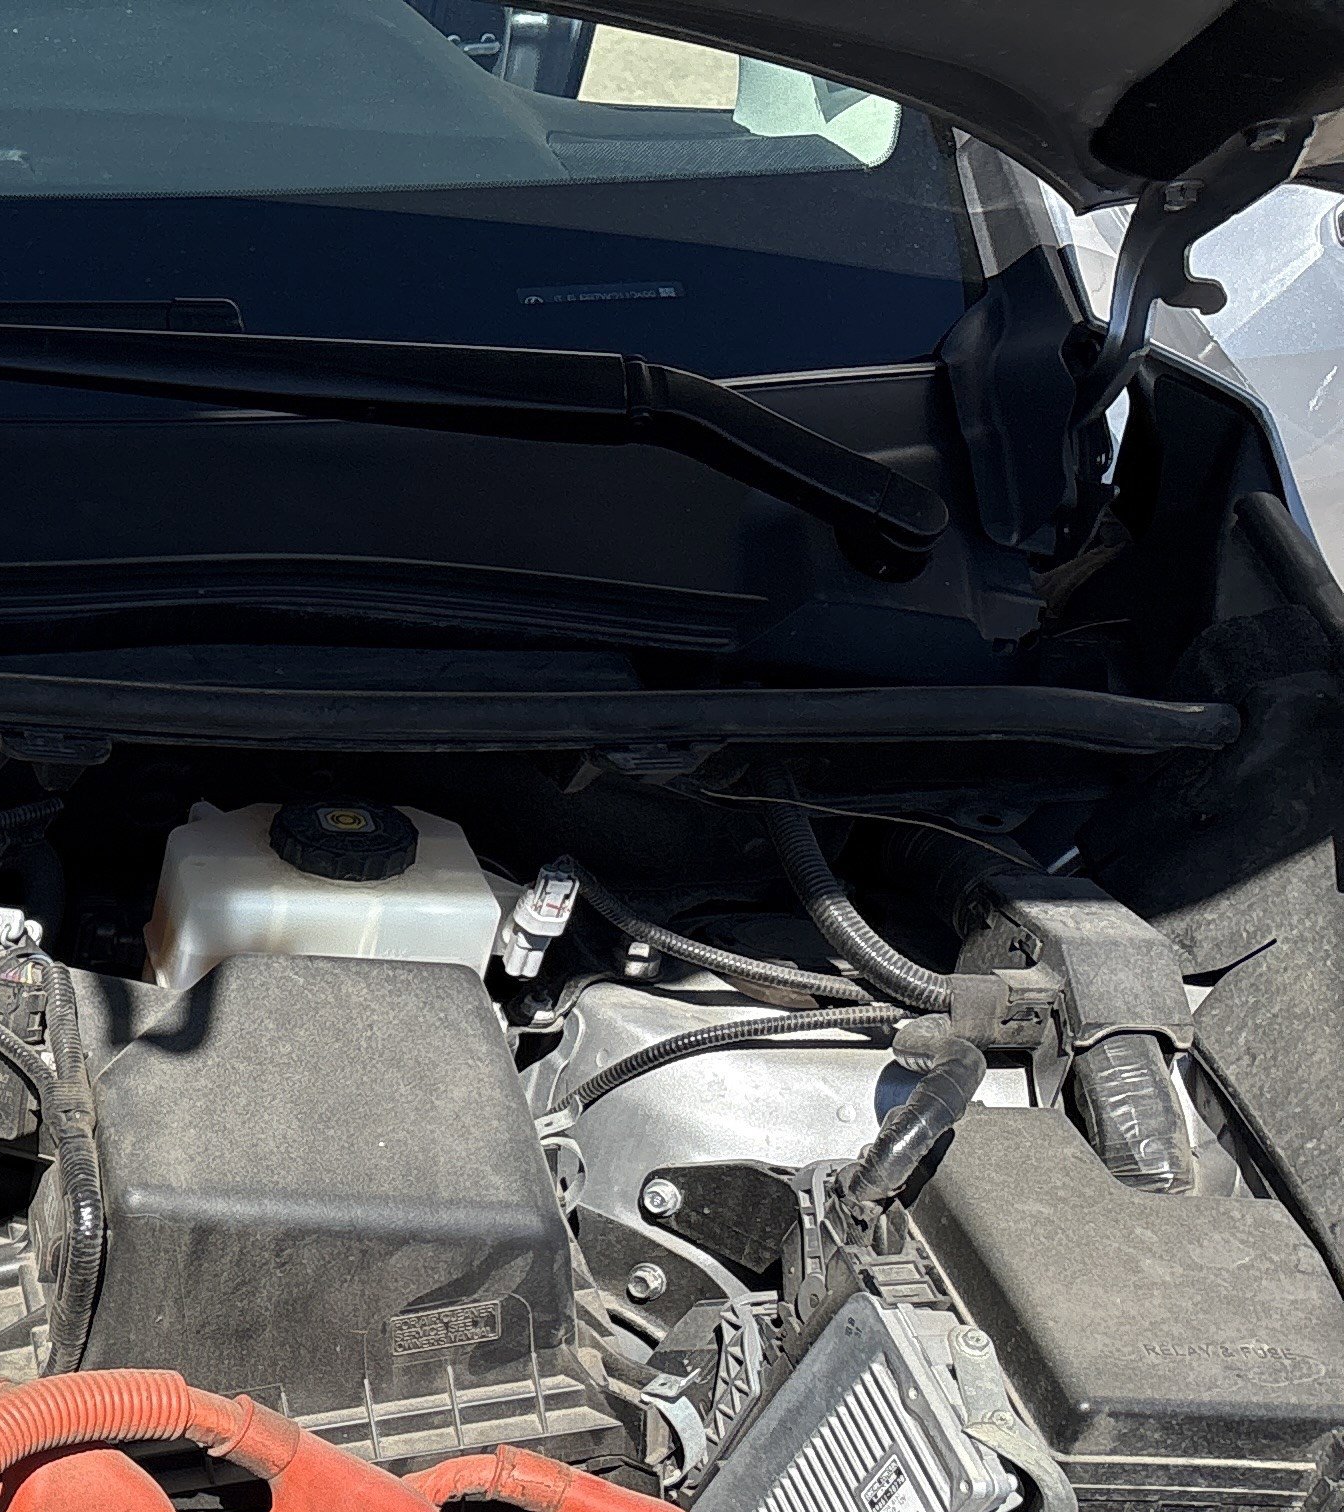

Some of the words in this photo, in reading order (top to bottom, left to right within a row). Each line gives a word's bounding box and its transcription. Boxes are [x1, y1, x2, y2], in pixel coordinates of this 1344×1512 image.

[448, 1318, 473, 1332] SEE
[1142, 1343, 1212, 1358] RELAY
[1219, 1345, 1236, 1358] &
[1239, 1346, 1297, 1361] FUSE
